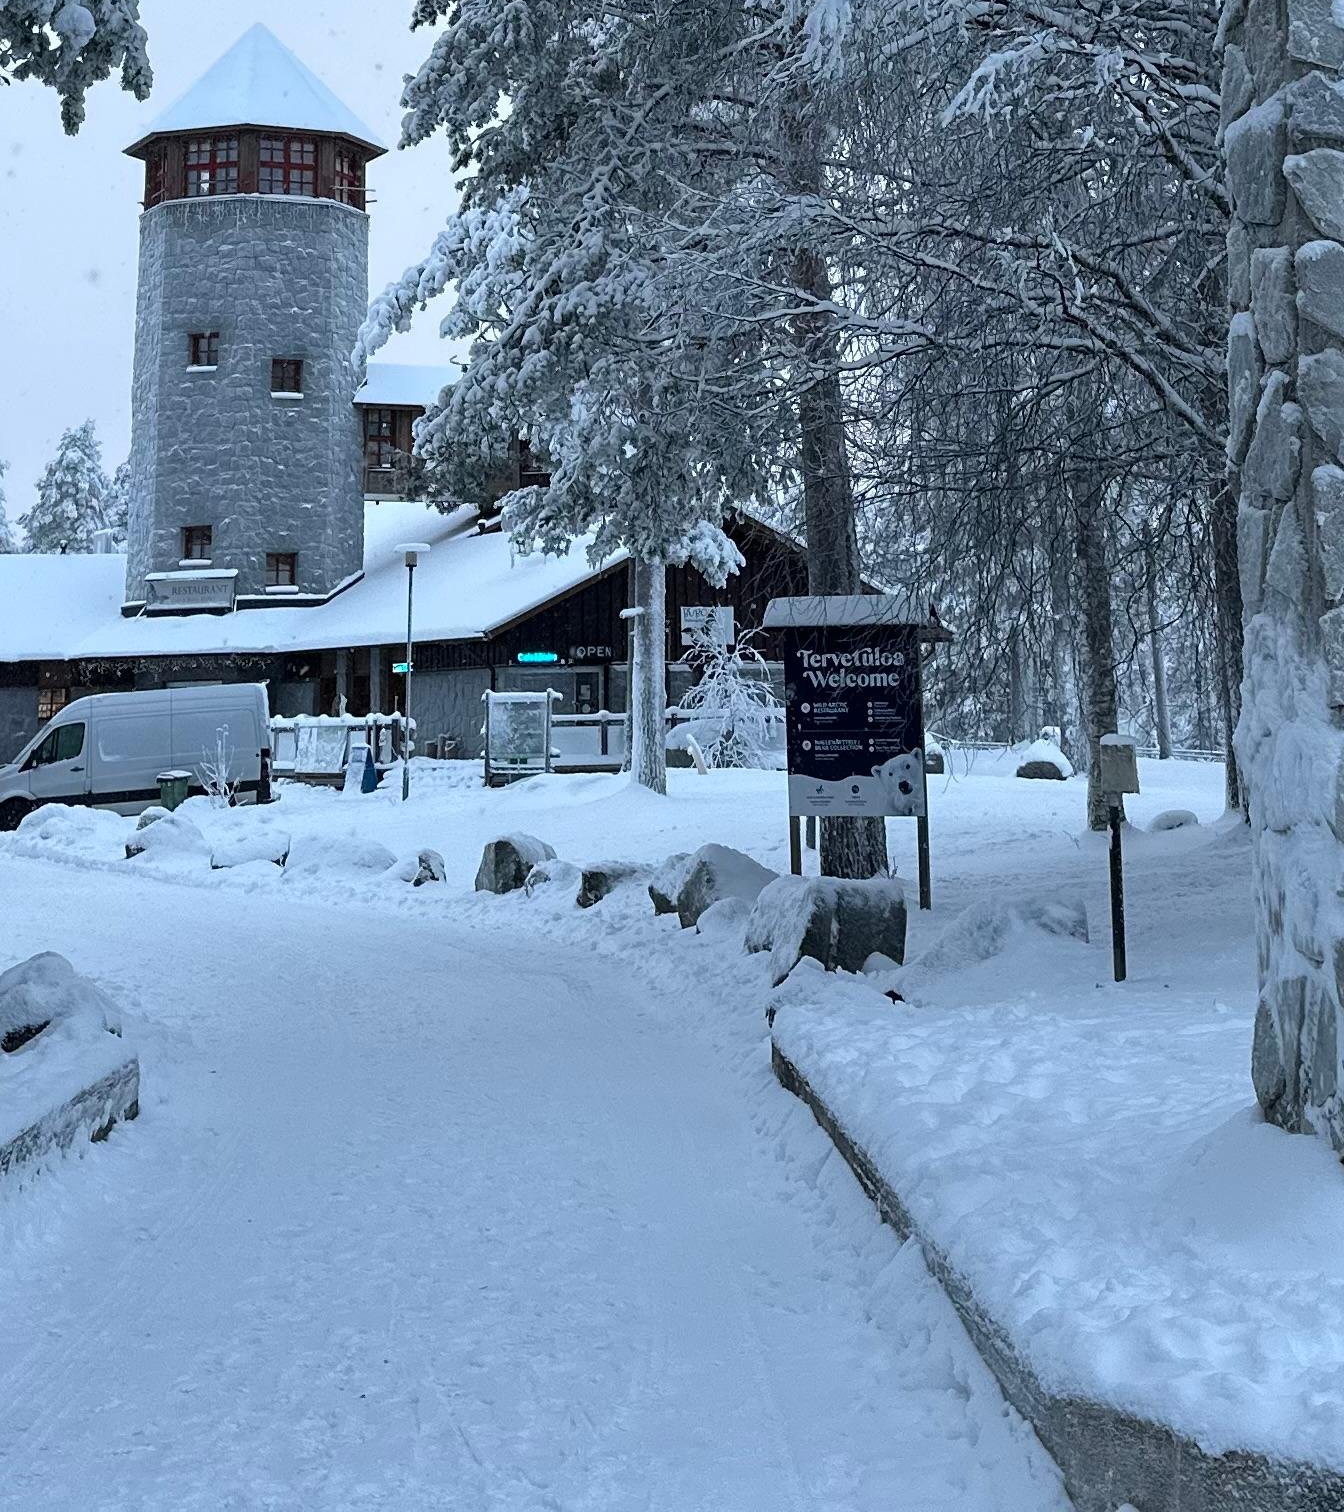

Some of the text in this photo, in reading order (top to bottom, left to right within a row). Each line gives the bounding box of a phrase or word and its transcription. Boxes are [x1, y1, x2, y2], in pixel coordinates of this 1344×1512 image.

[172, 584, 228, 596] RESTAURANT
[796, 647, 904, 668] Tervetuloa
[802, 669, 900, 688] Welcome
